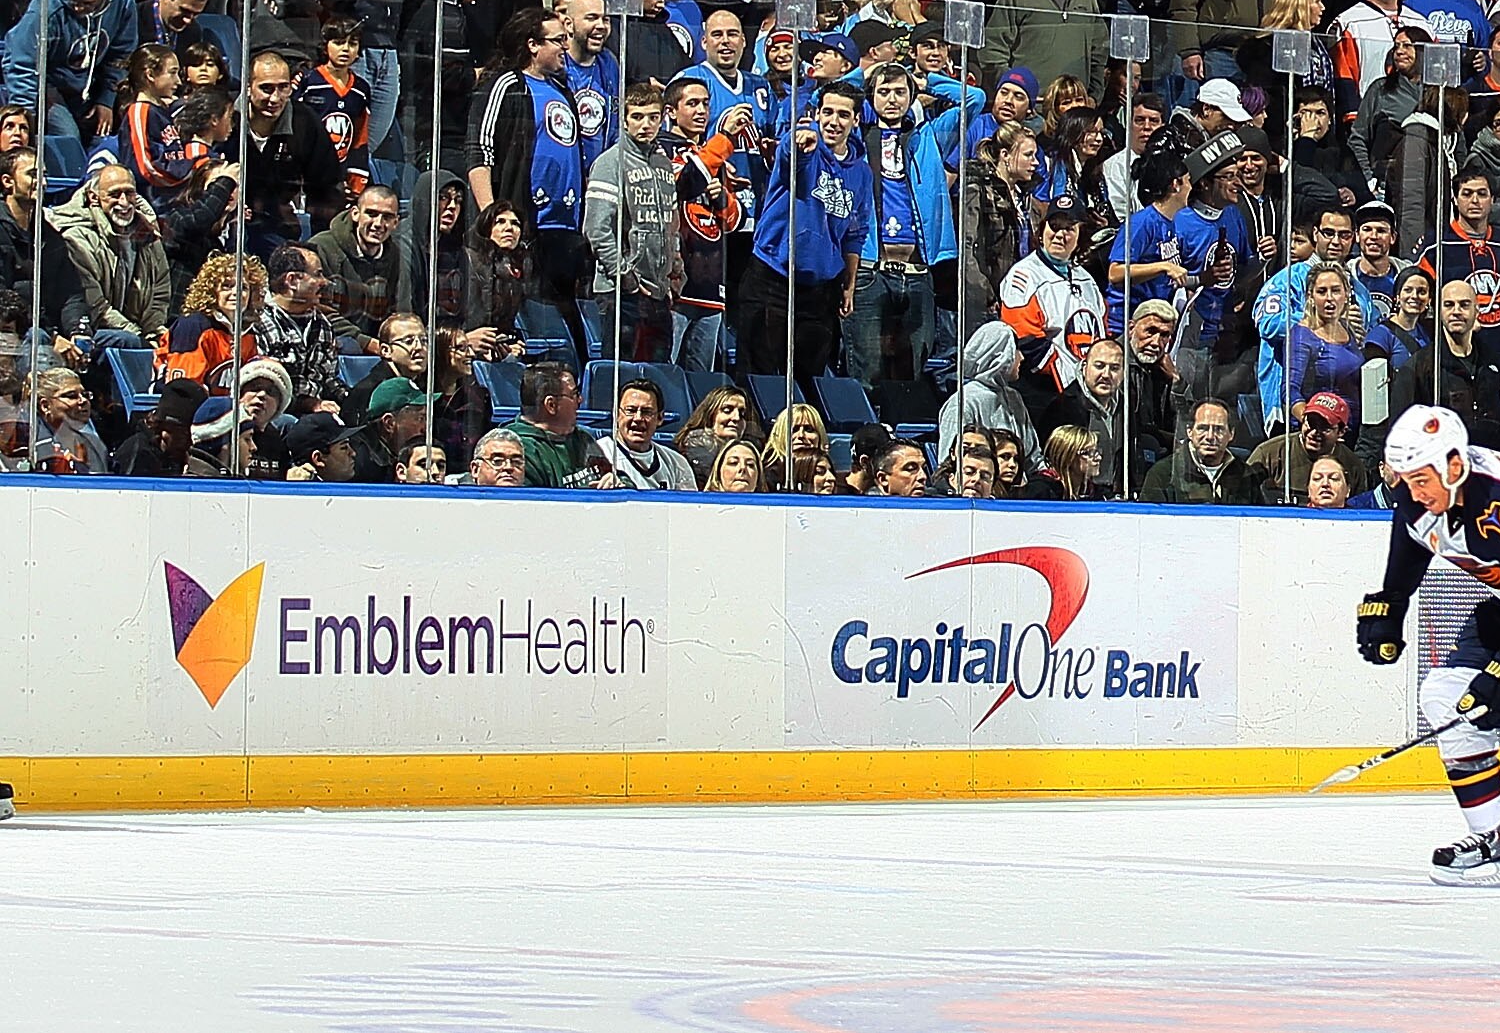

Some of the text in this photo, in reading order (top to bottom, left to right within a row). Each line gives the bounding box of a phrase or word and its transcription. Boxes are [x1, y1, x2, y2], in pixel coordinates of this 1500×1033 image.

[755, 87, 768, 110] C
[1200, 141, 1222, 164] NY
[279, 595, 646, 675] EmblemHealth
[1103, 650, 1202, 698] Bank
